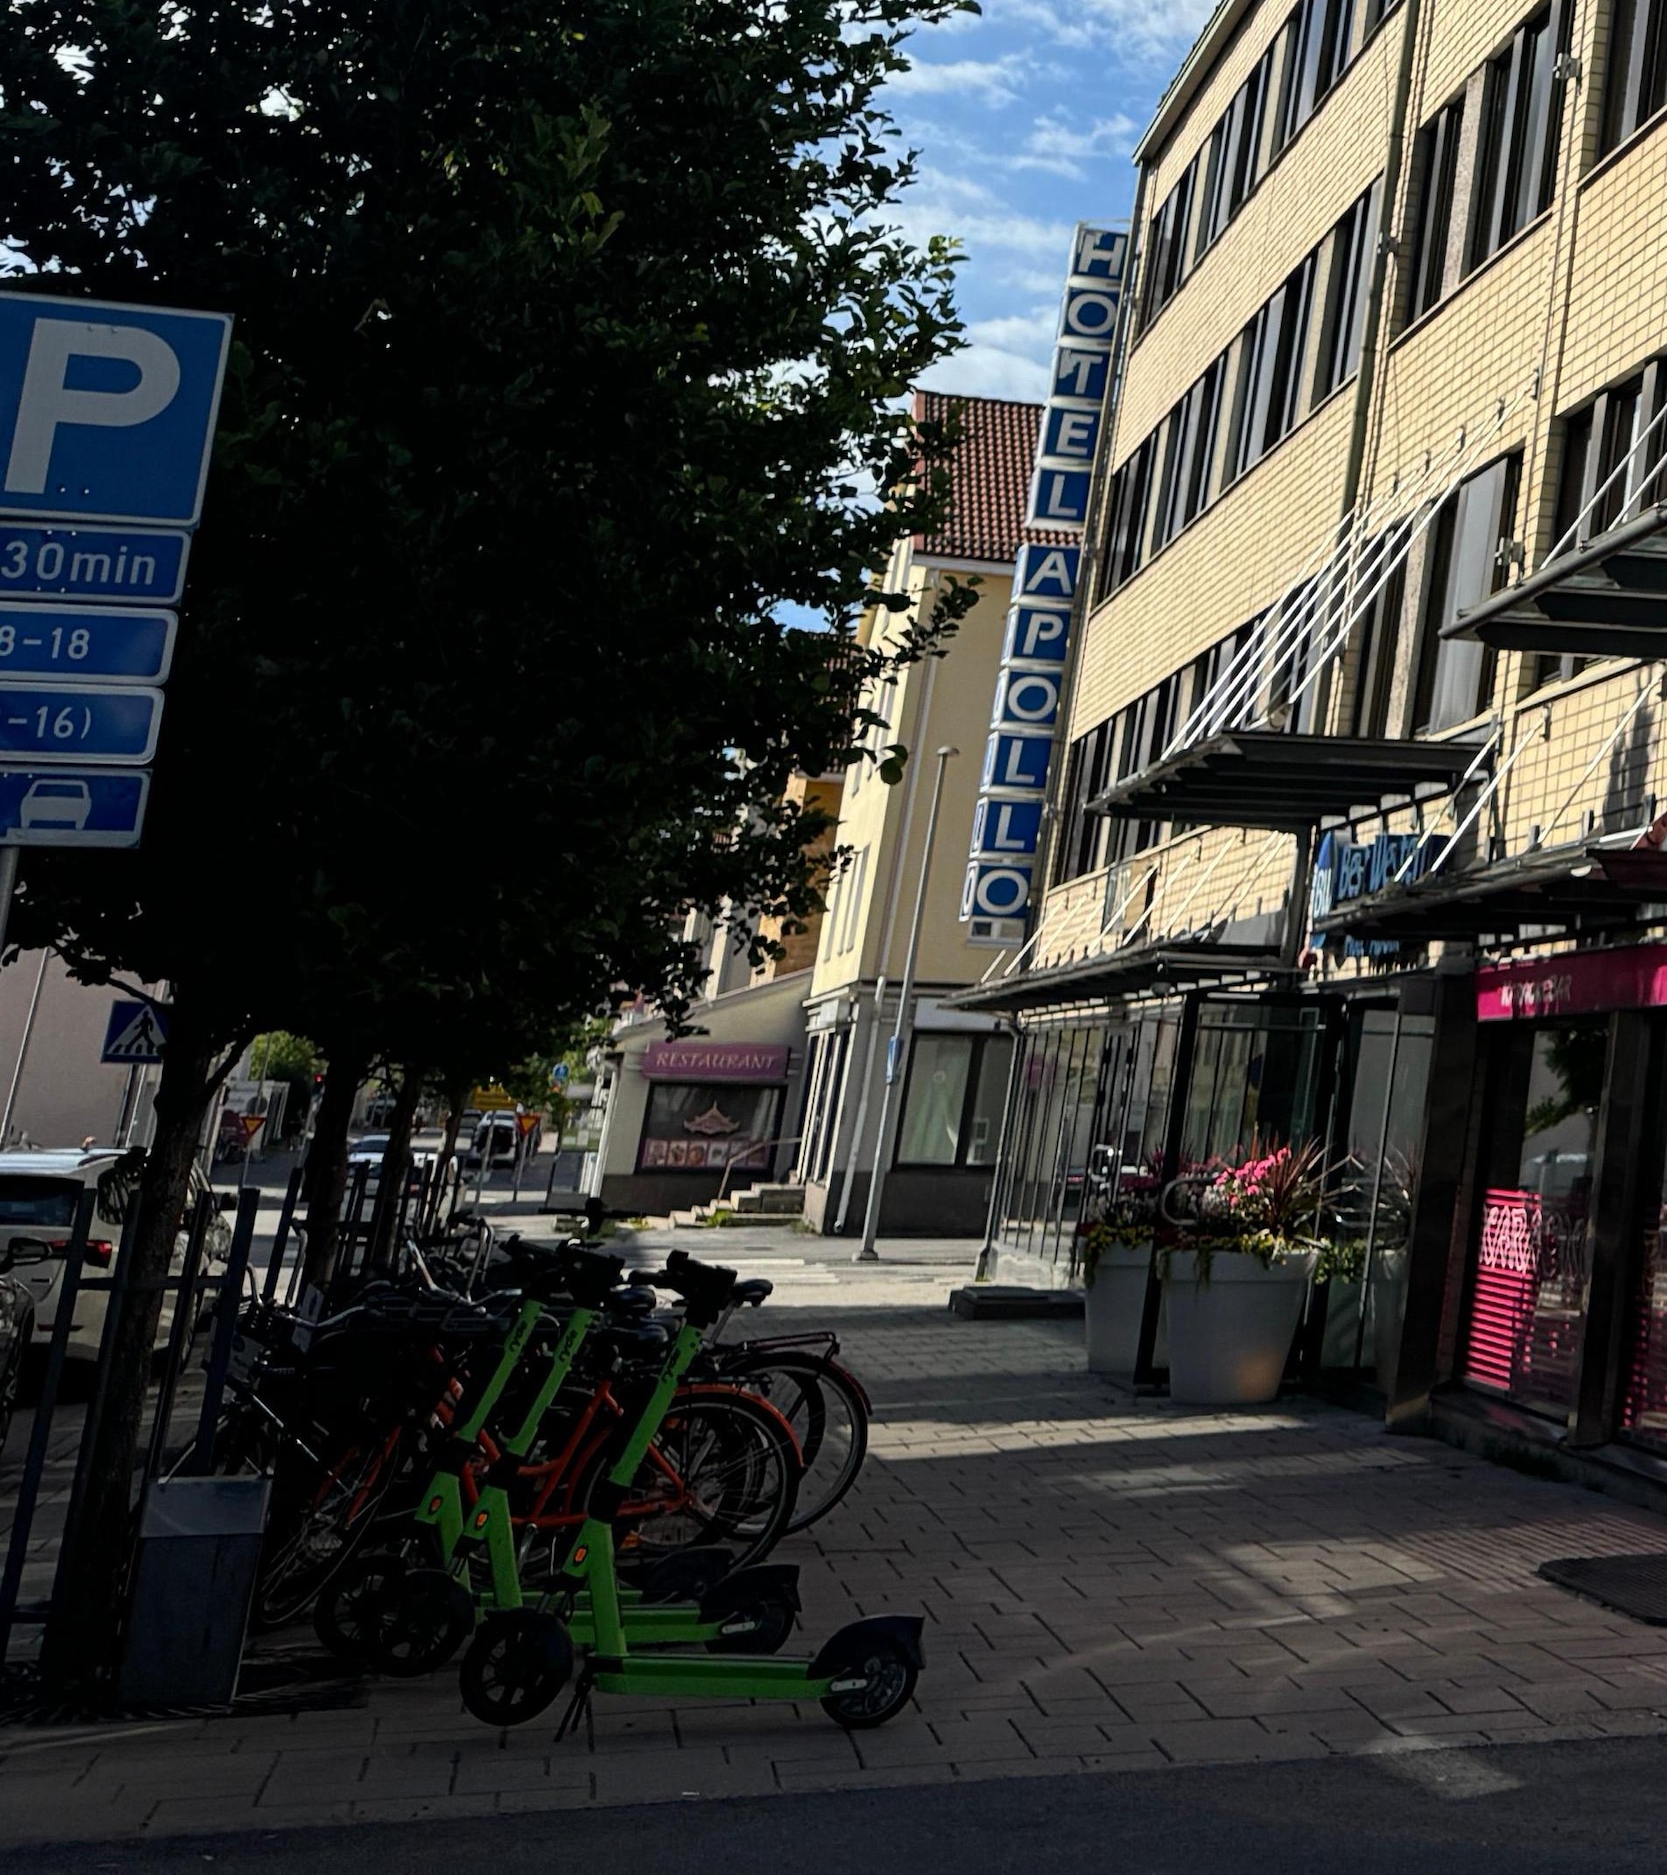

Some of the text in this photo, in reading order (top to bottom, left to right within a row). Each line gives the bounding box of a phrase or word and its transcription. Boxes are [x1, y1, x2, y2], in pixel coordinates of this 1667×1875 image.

[4, 318, 181, 494] P
[1047, 231, 1126, 518] HOTEL
[0, 705, 92, 740] -16)
[976, 551, 1072, 916] APOLLO
[655, 1051, 776, 1070] RESTAURANT
